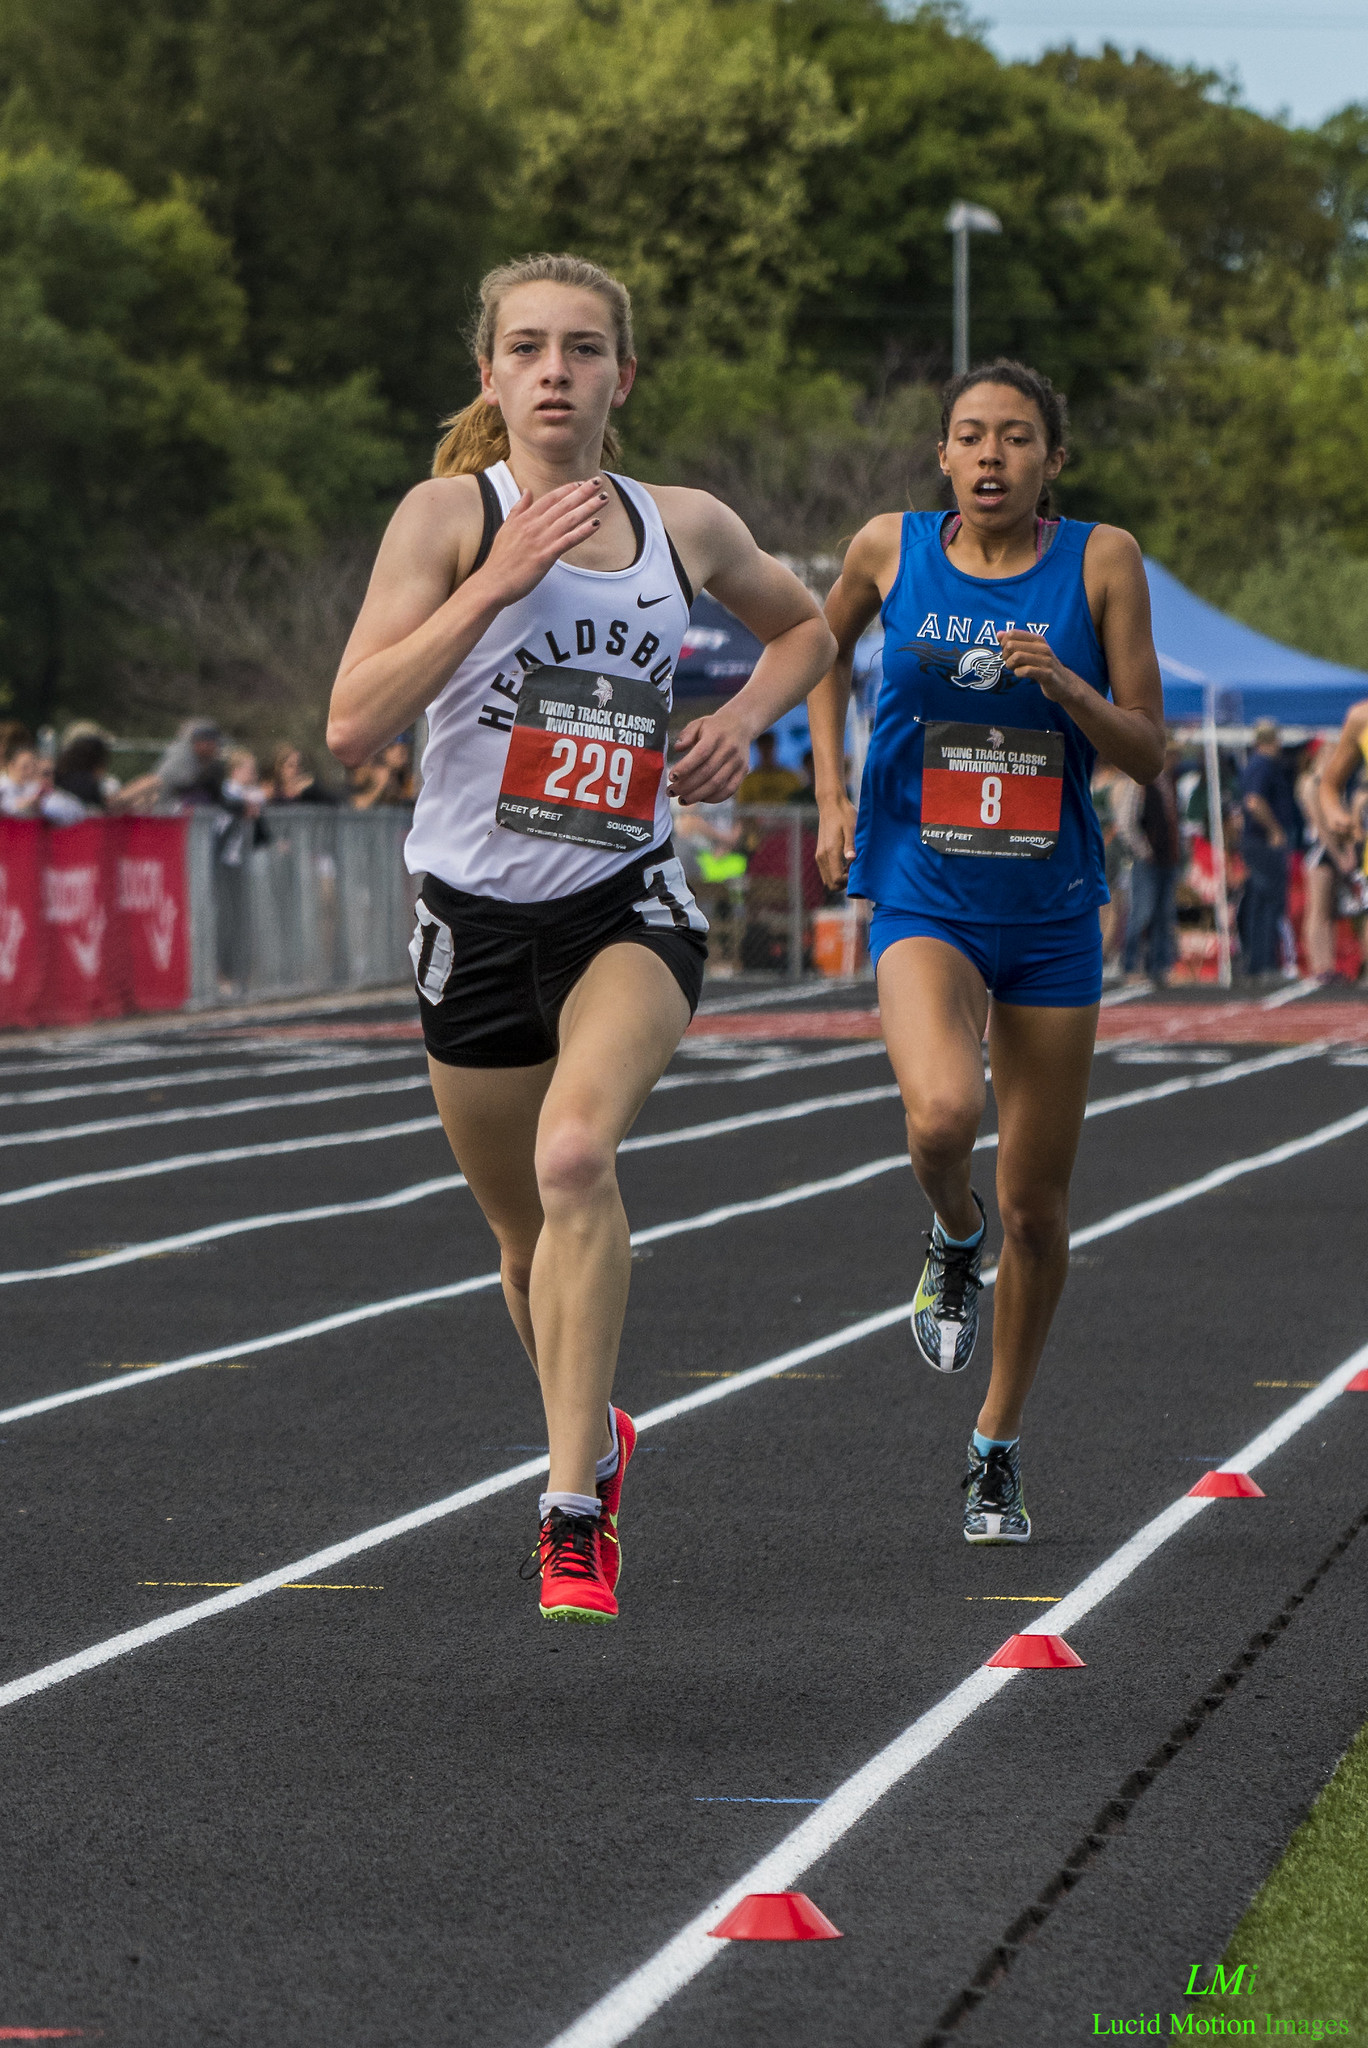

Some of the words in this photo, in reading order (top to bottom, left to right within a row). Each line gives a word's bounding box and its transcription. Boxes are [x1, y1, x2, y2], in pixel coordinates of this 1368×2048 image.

[539, 699, 576, 719] VIKING
[577, 705, 613, 726] TRACK
[613, 712, 656, 734] CLASSIC
[545, 716, 616, 743] INVITATIONAL
[618, 729, 645, 748] 2019
[941, 746, 973, 760] VIKING
[975, 748, 1006, 762] TRACK
[1008, 751, 1047, 766] CLASSIC
[543, 738, 634, 809] 229
[948, 759, 1010, 774] INVITATIONAL
[1011, 763, 1038, 777] 2019
[980, 776, 1003, 825] 8
[500, 802, 529, 815] FLEET
[539, 809, 563, 821] FEET
[606, 820, 644, 836] saucony
[922, 829, 946, 839] FLEET
[953, 832, 973, 841] FEET
[1009, 835, 1047, 845] saucony
